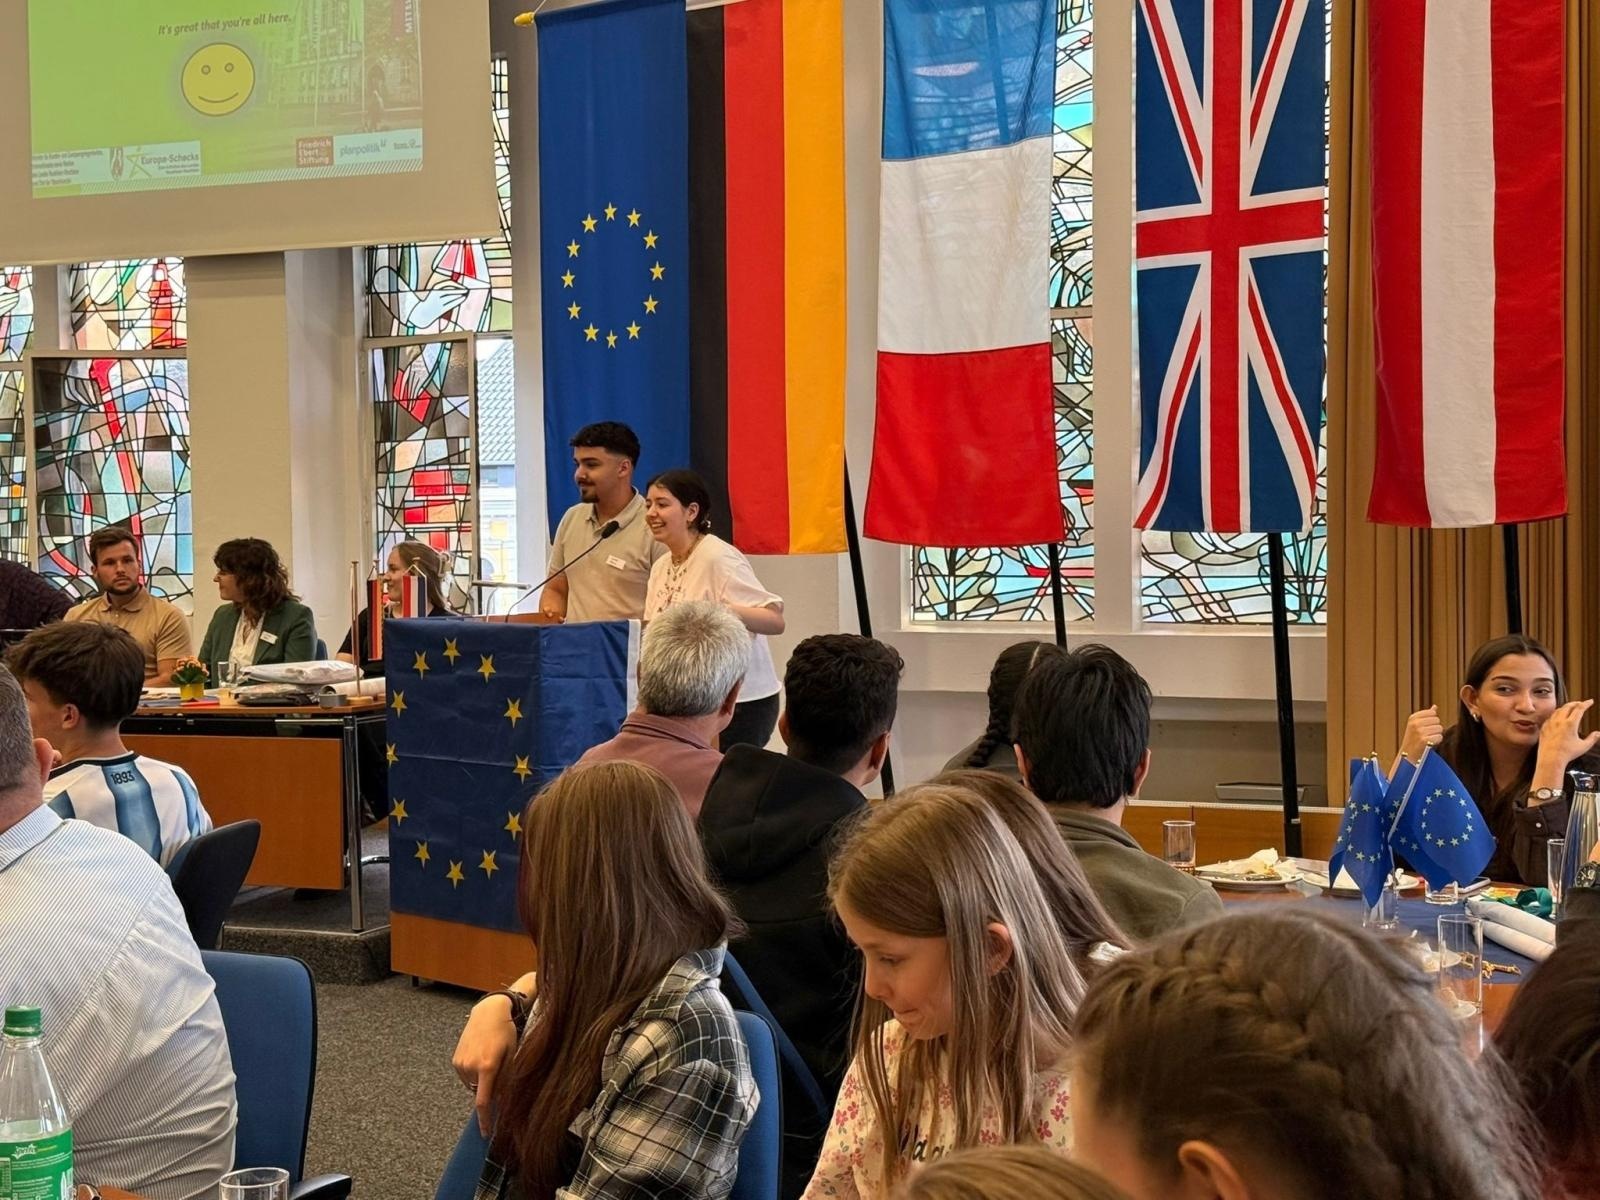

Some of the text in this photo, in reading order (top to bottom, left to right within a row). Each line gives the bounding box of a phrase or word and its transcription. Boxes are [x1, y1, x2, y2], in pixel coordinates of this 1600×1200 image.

[158, 13, 292, 36] It's great that you're all here.
[110, 771, 135, 785] 1893
